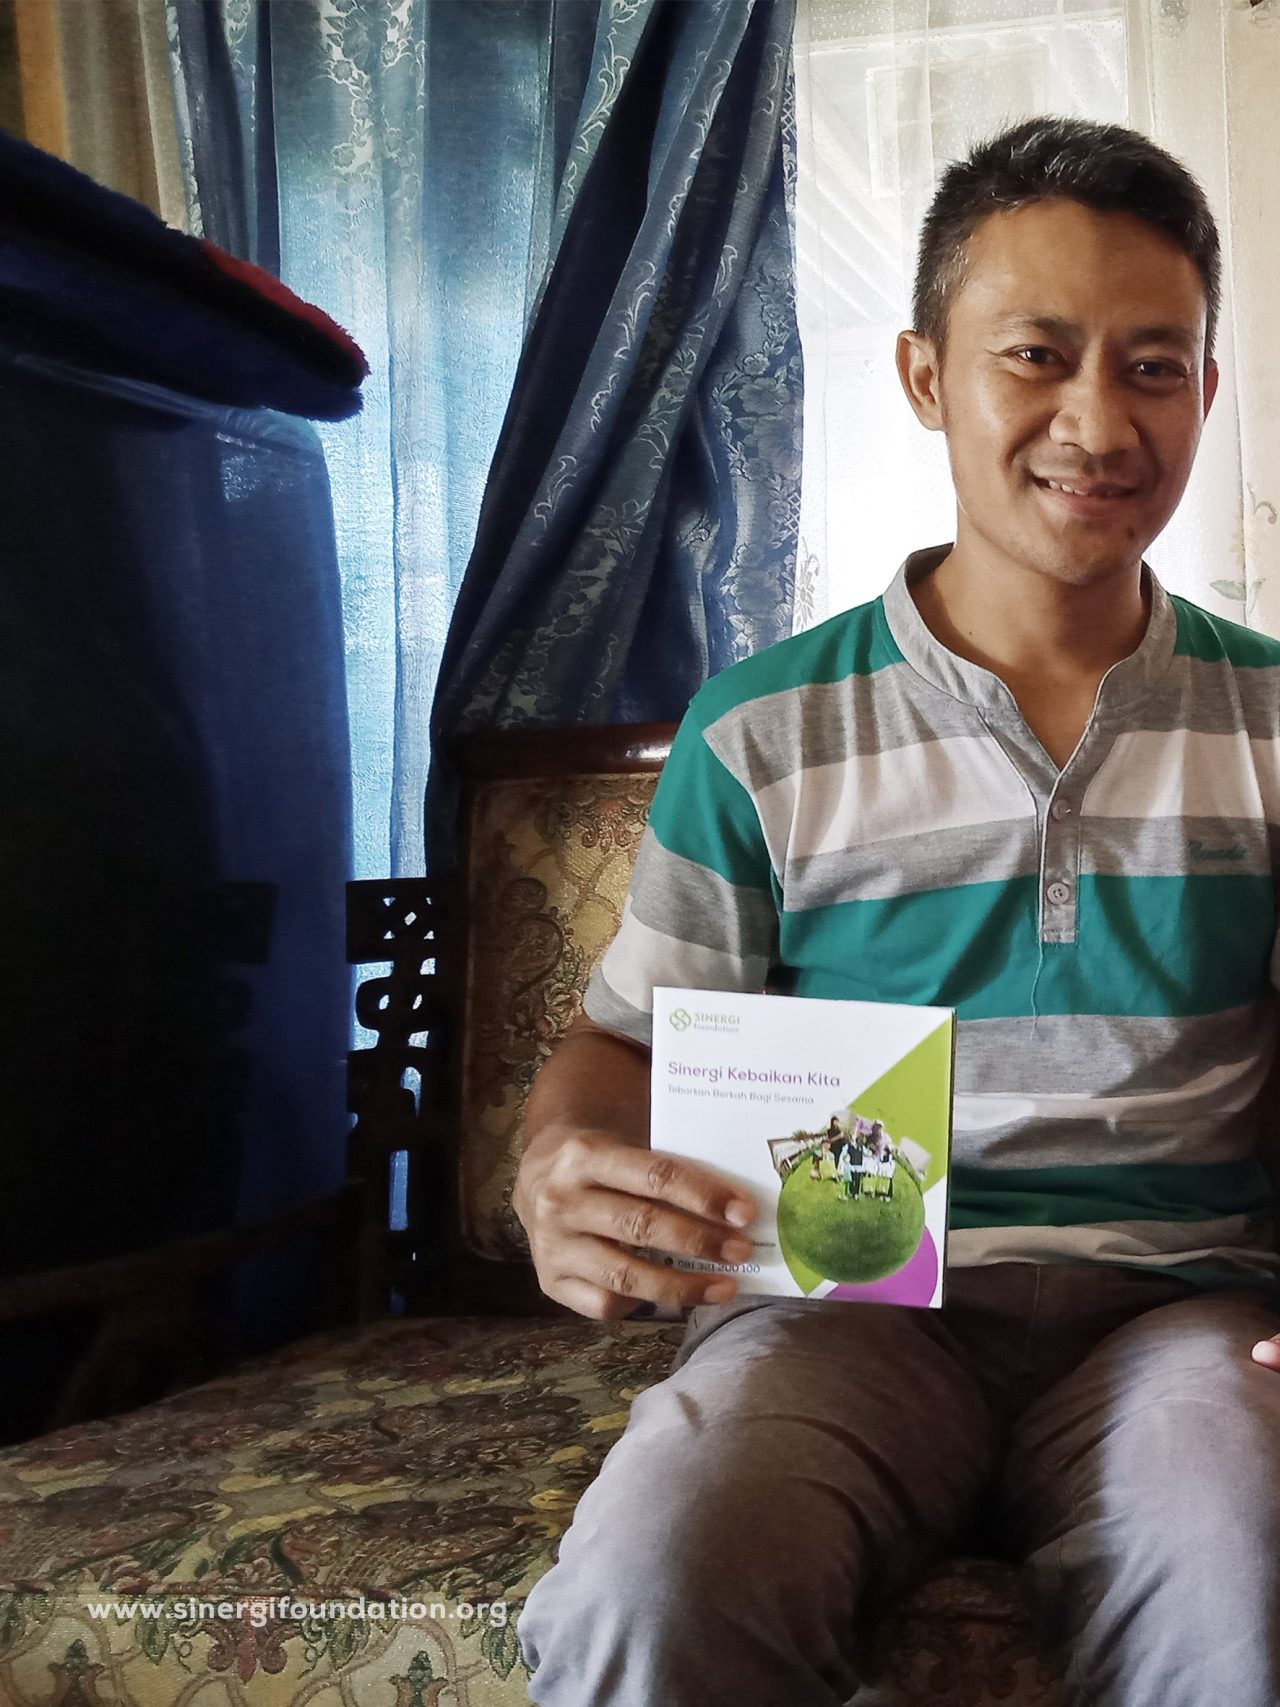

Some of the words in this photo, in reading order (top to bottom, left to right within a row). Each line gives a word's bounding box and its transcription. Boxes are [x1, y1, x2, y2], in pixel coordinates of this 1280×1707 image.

[694, 1012, 740, 1025] SINERGI
[693, 1022, 740, 1033] foundation
[668, 1061, 723, 1083] Sinergi
[727, 1066, 803, 1086] Kebaikan
[807, 1071, 841, 1087] Kita
[667, 1084, 711, 1097] Tebarkan
[713, 1089, 748, 1100] Berkah
[750, 1092, 772, 1104] Bagi
[774, 1094, 814, 1105] Sesama
[742, 1264, 761, 1274] 100
